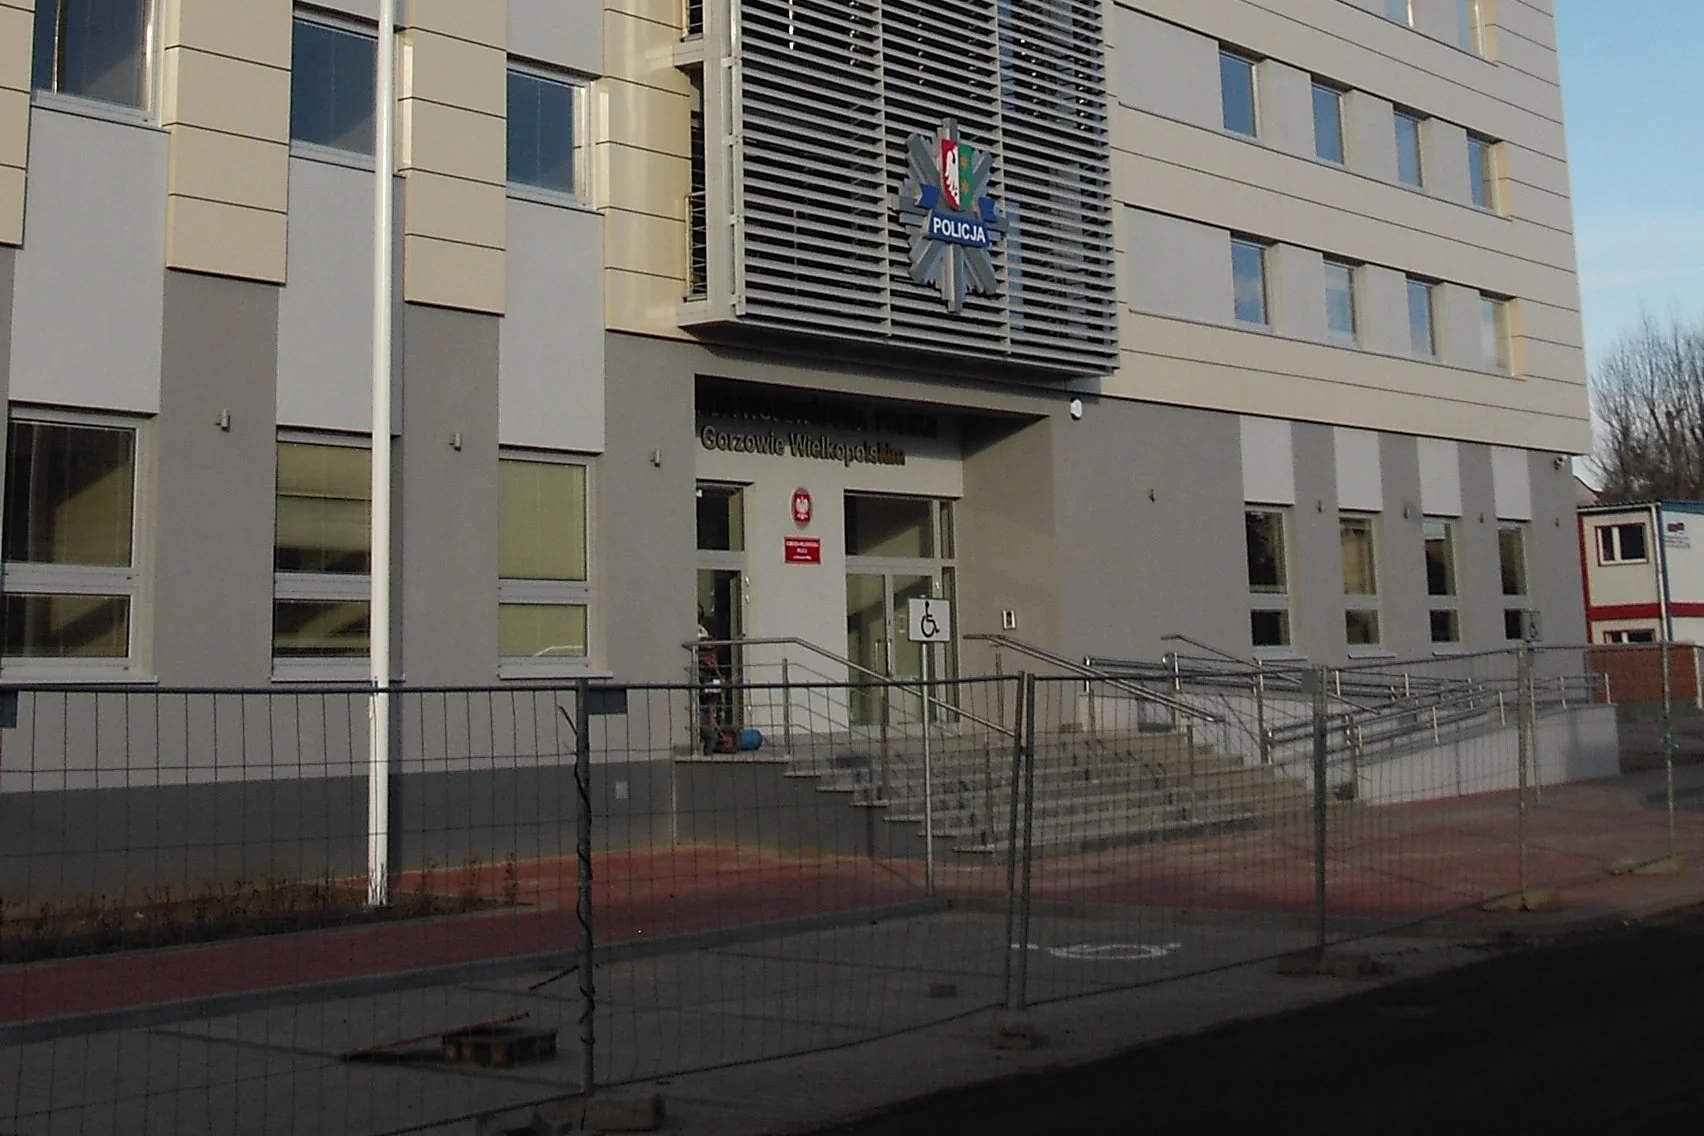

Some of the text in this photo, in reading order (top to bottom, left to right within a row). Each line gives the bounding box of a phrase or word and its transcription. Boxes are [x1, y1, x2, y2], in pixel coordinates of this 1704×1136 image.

[933, 217, 986, 243] POLICJA
[701, 425, 905, 467] Gorzowie Wielkopolskim
